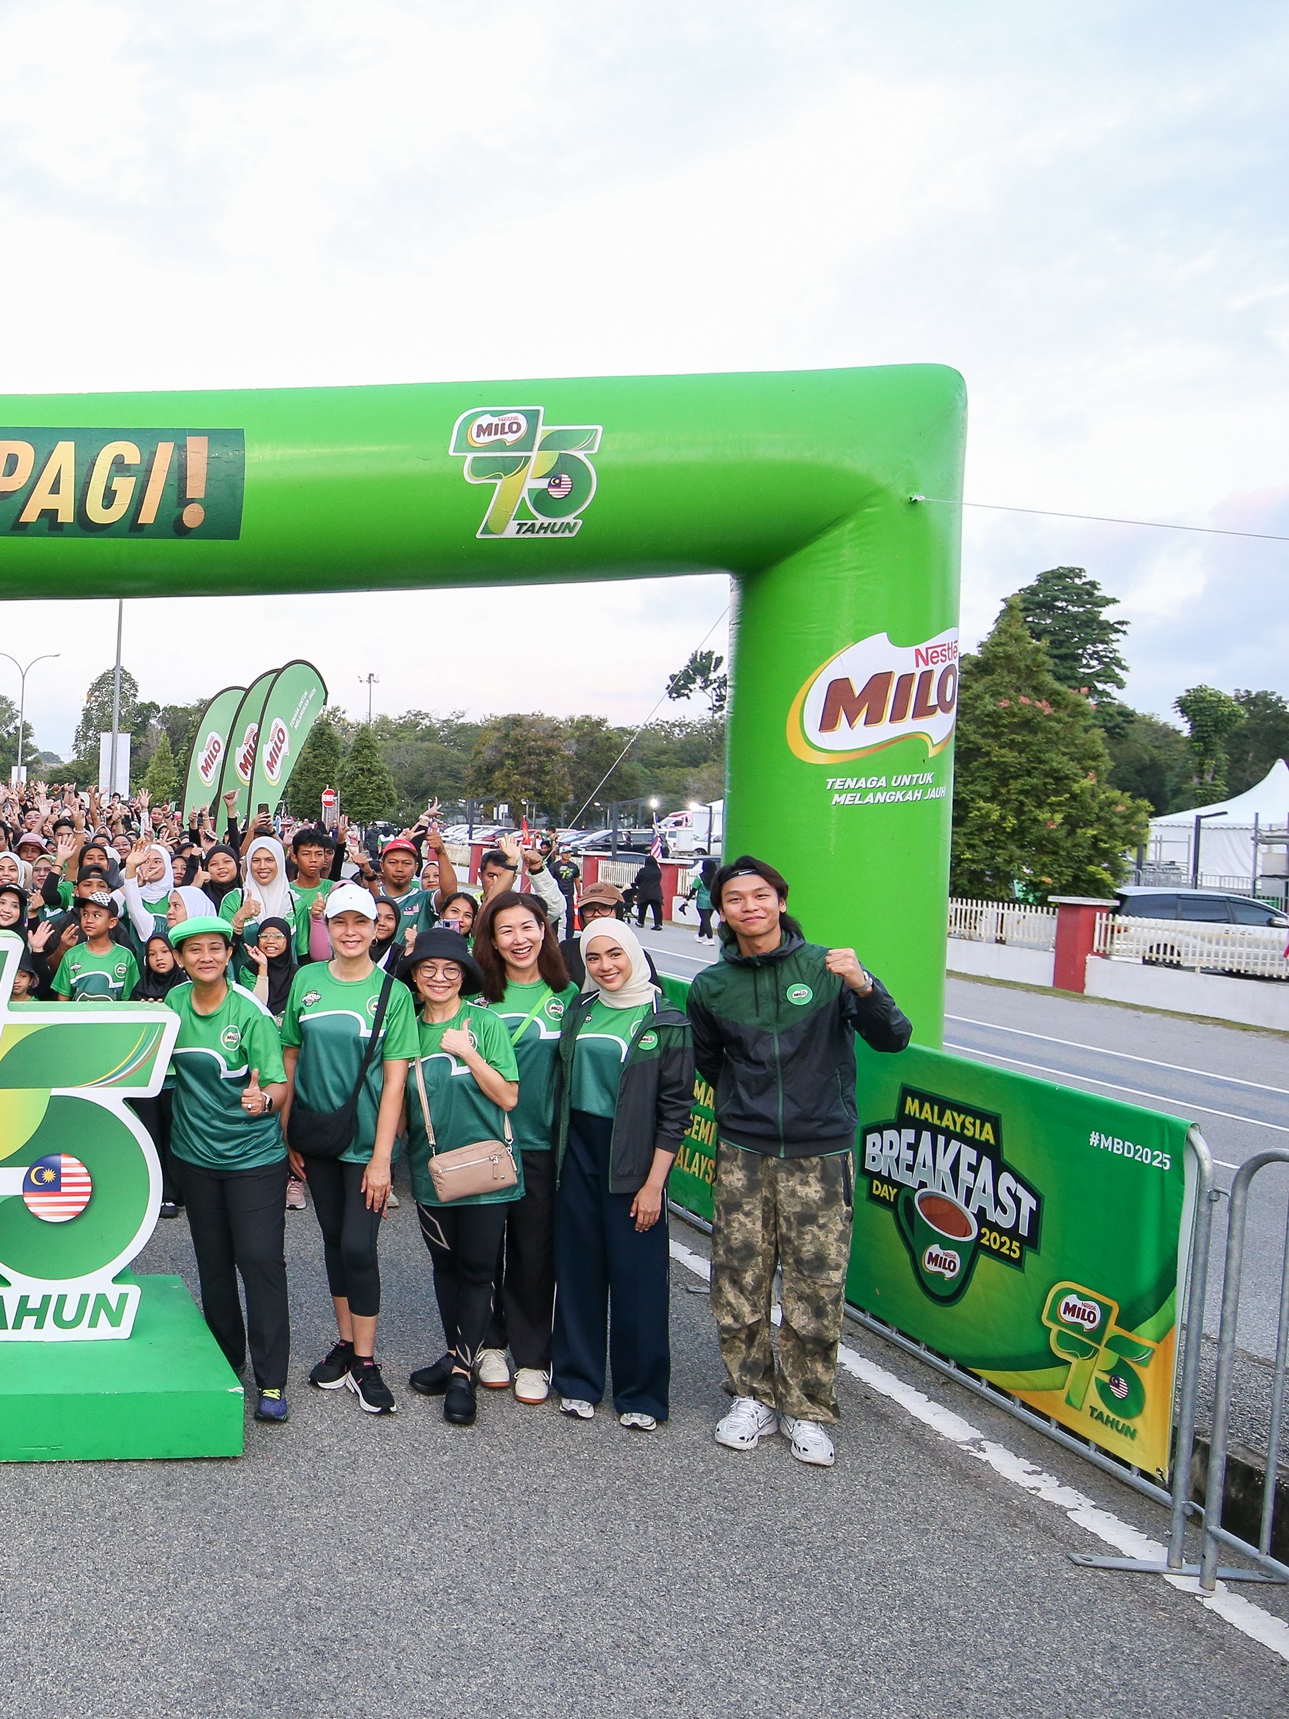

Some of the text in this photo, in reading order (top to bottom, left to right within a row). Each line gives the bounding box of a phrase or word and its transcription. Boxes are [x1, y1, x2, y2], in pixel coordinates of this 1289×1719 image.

[476, 420, 521, 438] MILO
[515, 521, 578, 535] TAHUN
[914, 639, 958, 668] Nestlé
[818, 664, 958, 733] MILO
[201, 740, 221, 778] MILO
[266, 728, 286, 776] MILO
[826, 772, 934, 790] TENAGA UNTUK
[831, 786, 947, 805] MELANGKAH JAUH
[904, 1096, 996, 1145] MALAYSIA
[1089, 1130, 1171, 1171] #MBD2025
[864, 1129, 1037, 1237] BREAKFAST
[872, 1180, 898, 1202] DAY
[980, 1227, 1021, 1259] 2025
[927, 1251, 957, 1274] MILO
[1062, 1301, 1097, 1324] MILO
[1089, 1404, 1138, 1441] TAHUN
